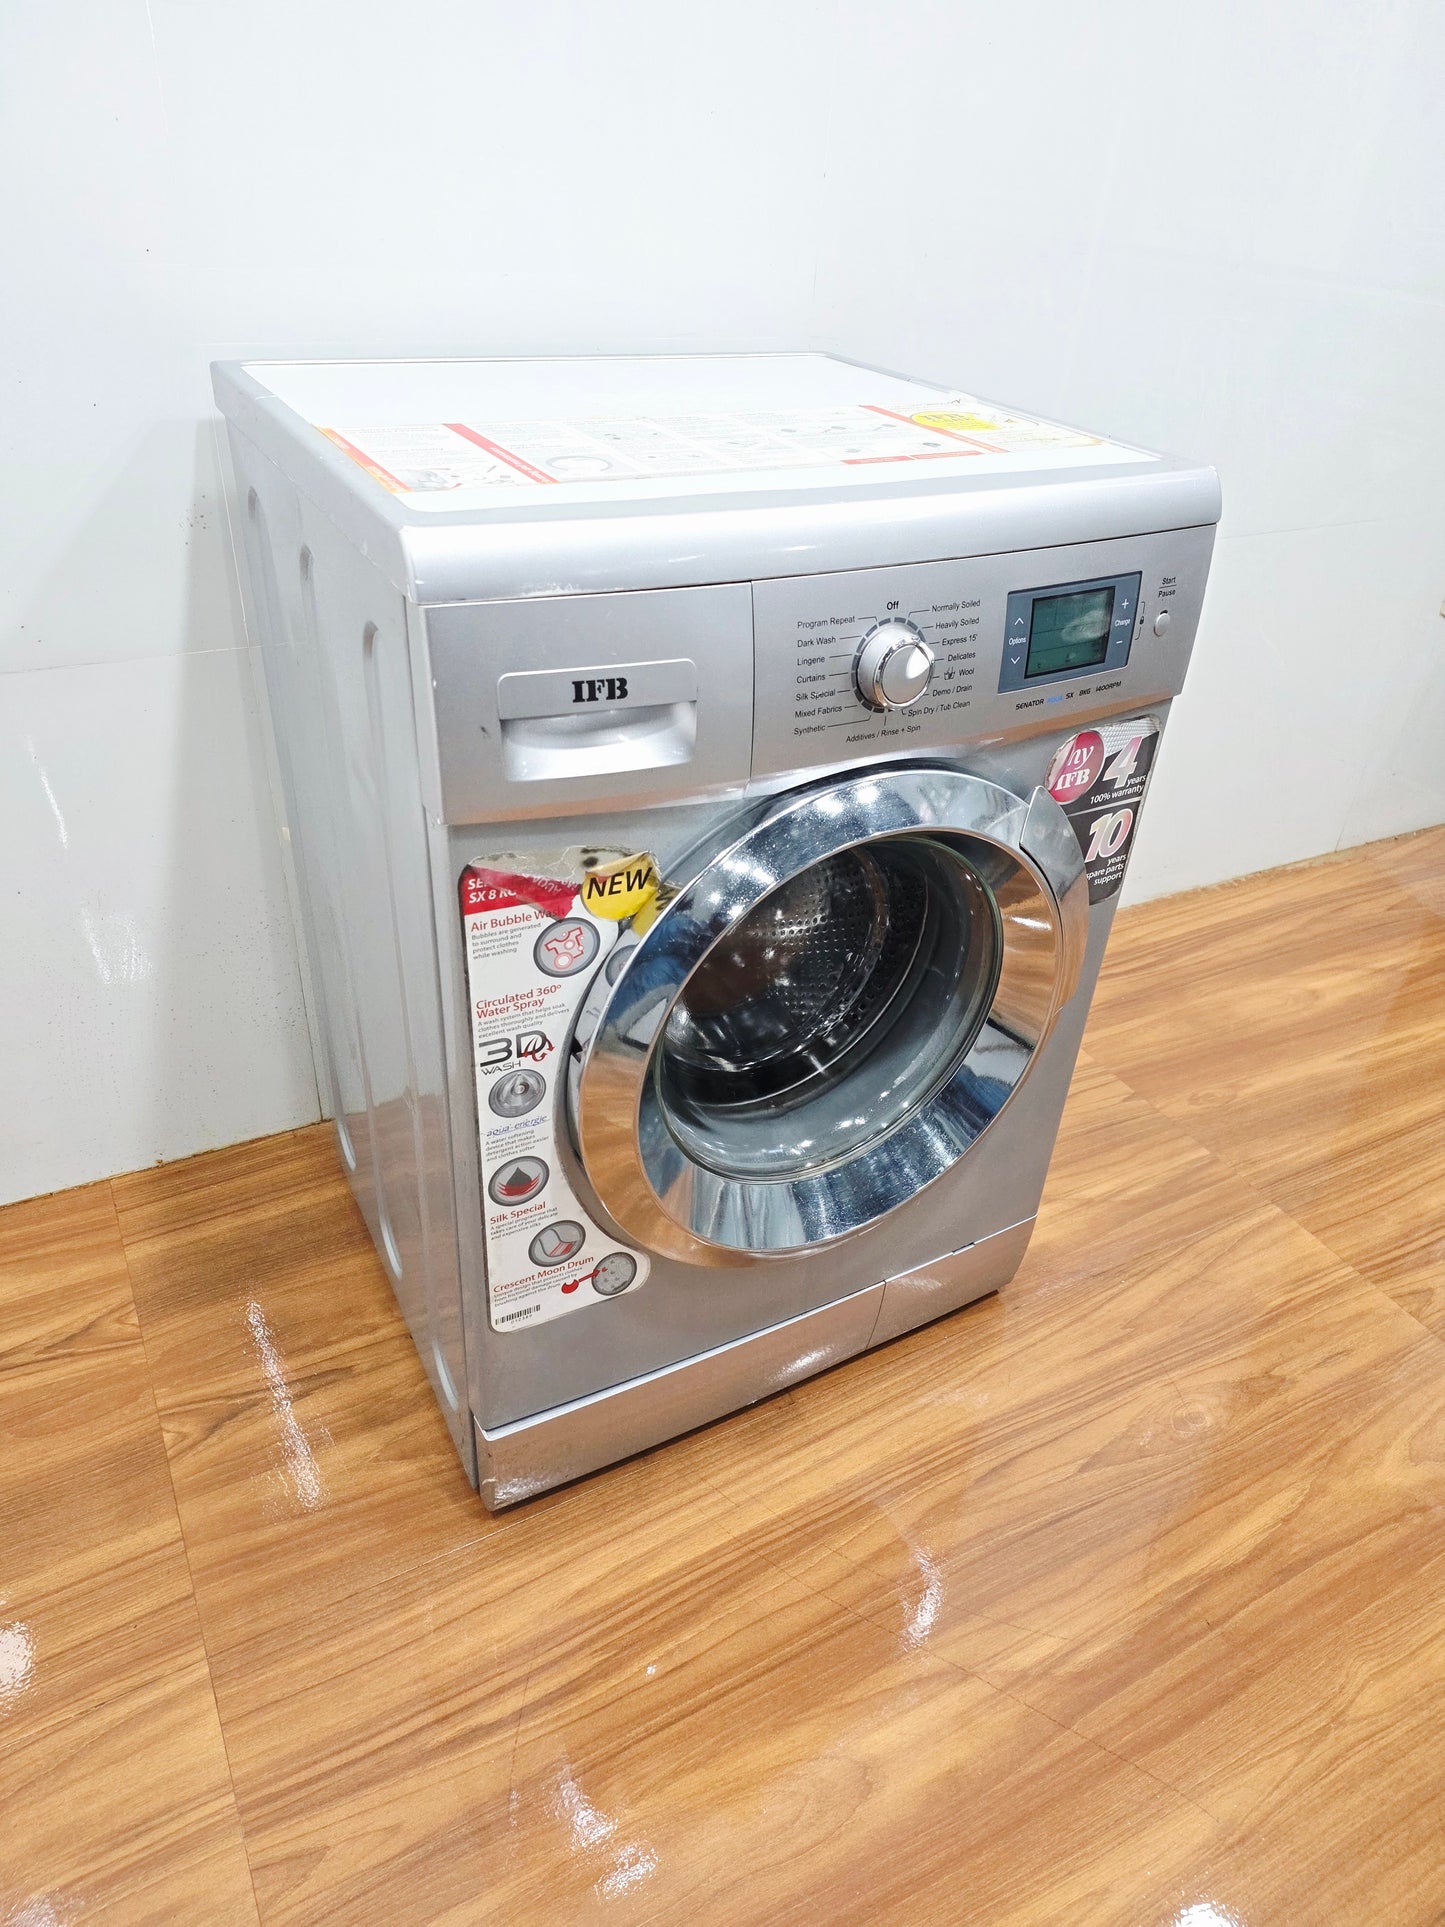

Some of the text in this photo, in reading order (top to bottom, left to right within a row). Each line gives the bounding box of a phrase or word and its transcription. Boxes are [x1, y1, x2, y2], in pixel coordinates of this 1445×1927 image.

[1162, 577, 1176, 585] Start
[1158, 588, 1176, 598] Pause
[886, 601, 900, 611] Off
[931, 600, 980, 613] Normally Soiled
[797, 616, 856, 630] Program Repeat
[935, 617, 980, 630] Heavily Soiled
[1114, 618, 1131, 628] Change
[797, 636, 836, 648] Dark Wash
[942, 636, 967, 647] Express
[1008, 636, 1026, 646] Options
[797, 655, 826, 666] Lingerie
[947, 652, 976, 662] Delicates
[796, 673, 826, 684] Curtains
[959, 668, 975, 677] Wool
[572, 677, 629, 704] IFB
[796, 689, 836, 702] Silk Special
[932, 687, 950, 697] Demo
[956, 684, 972, 693] Drain
[1015, 698, 1044, 710] SENATOR
[1065, 692, 1074, 700] SX
[794, 705, 842, 718] Mixed Fabrics
[908, 708, 922, 718] Spin
[923, 706, 935, 716] Dry
[940, 704, 951, 712] Tub
[952, 700, 970, 710] Clean
[794, 724, 826, 736] Synthetic
[846, 732, 876, 743] Additives
[880, 727, 899, 737] Rinse
[906, 724, 921, 734] Spin
[1066, 744, 1094, 770] hy
[1102, 736, 1143, 789] 4
[1054, 768, 1090, 792] IFB
[1126, 774, 1147, 788] years
[1090, 785, 1145, 805] 100% warranty
[1084, 808, 1134, 864] 10
[1107, 854, 1127, 867] years
[1106, 862, 1124, 874] parts
[587, 867, 653, 900] NEW
[1094, 872, 1123, 886] support
[468, 890, 486, 904] SX
[488, 889, 496, 900] 8
[471, 922, 488, 932] Air
[490, 912, 532, 928] Bubble
[472, 930, 497, 940] Bubbles
[510, 922, 542, 934] generated
[472, 940, 520, 955] protect clothes
[473, 948, 518, 960] while washing
[476, 989, 534, 1010] Circulated
[476, 998, 544, 1019] Water Spray
[481, 1060, 522, 1076] WASH
[490, 1201, 546, 1224] Silk Special
[493, 1256, 594, 1293] Crescent Moon Drum
